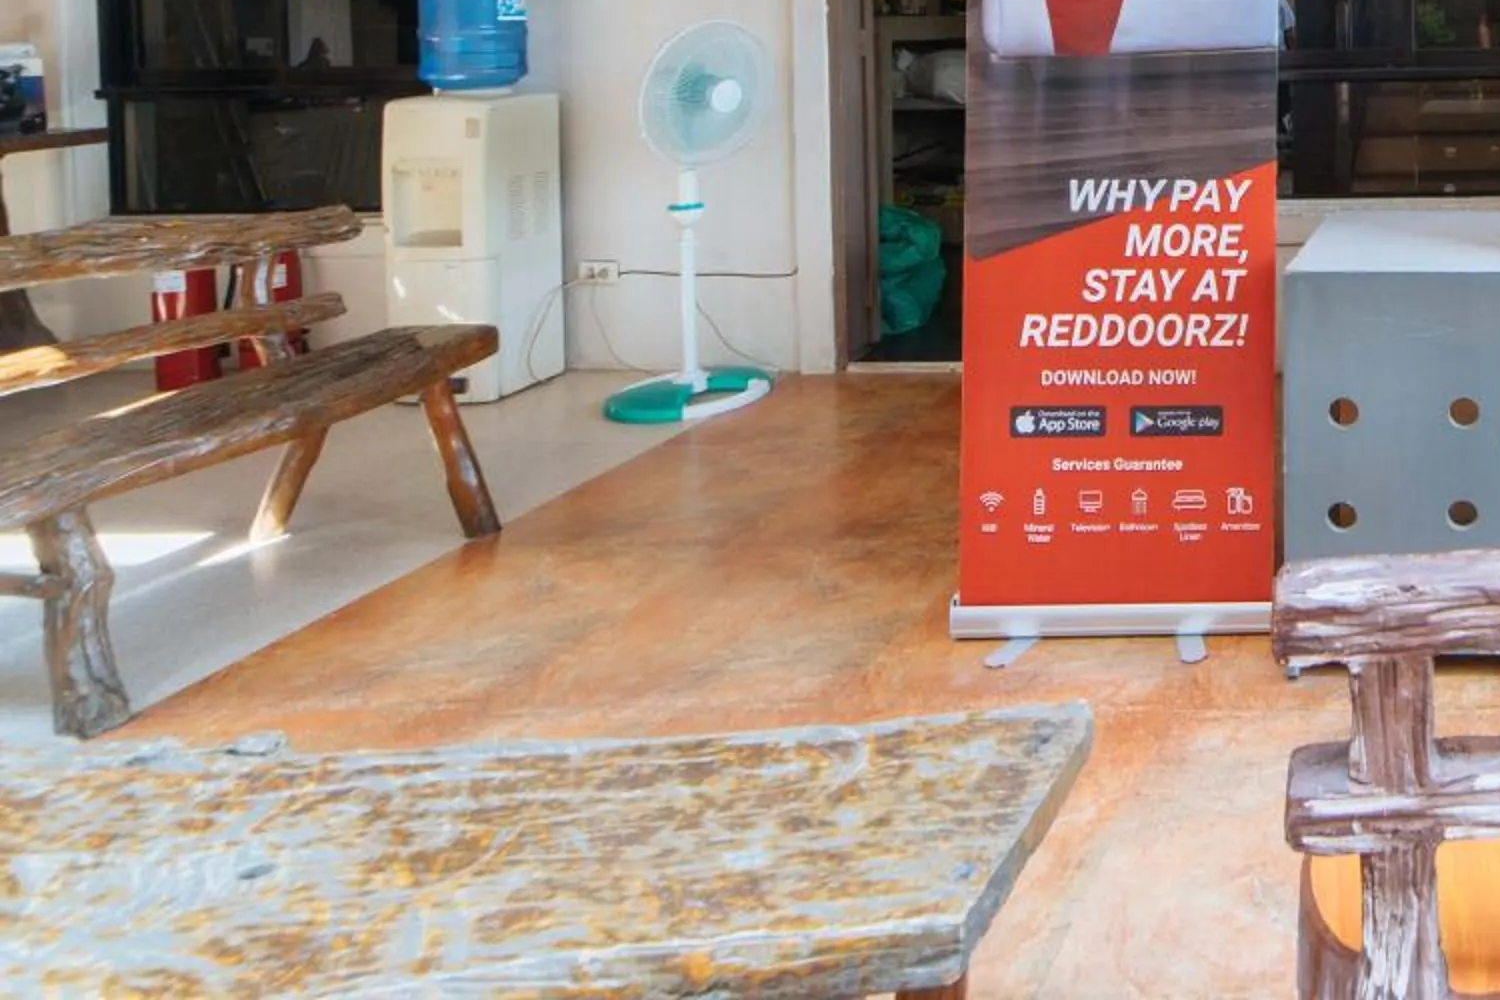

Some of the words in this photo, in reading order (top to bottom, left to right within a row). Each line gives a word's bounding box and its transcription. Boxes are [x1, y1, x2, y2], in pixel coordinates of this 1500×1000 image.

[1068, 178, 1167, 213] WHY
[1169, 178, 1252, 213] PAY
[1124, 224, 1250, 263] MORE,
[1082, 269, 1185, 303] STAY
[1191, 269, 1249, 303] AT
[1019, 313, 1250, 348] REDDOORZ!
[1041, 369, 1144, 386] DOWNLOAD
[1148, 369, 1197, 386] NOW!
[1038, 417, 1066, 434] App
[1067, 417, 1101, 431] Store
[1156, 414, 1196, 432] Google
[1052, 457, 1110, 471] Services
[1114, 457, 1183, 471] Guarantee
